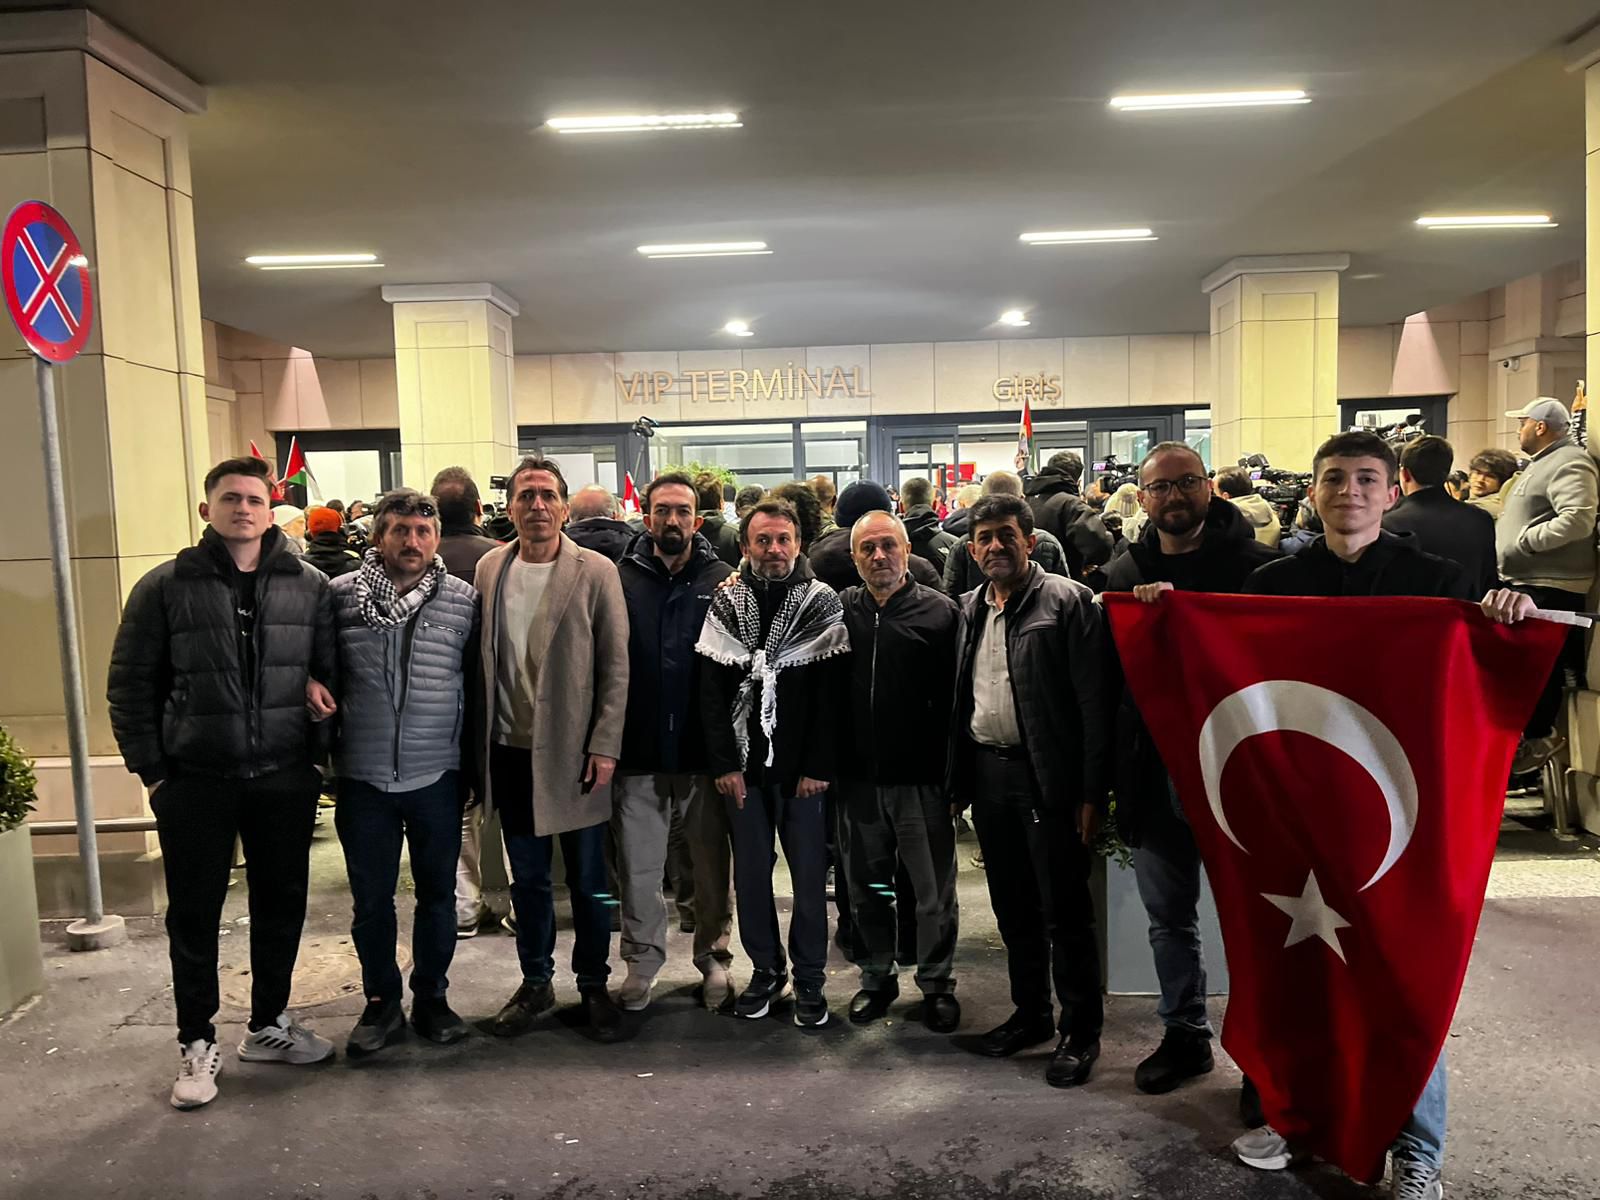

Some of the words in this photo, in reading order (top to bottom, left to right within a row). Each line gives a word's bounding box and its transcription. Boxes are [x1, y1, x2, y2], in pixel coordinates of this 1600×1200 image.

[615, 371, 673, 404] VIP
[682, 361, 872, 402] TERMİNAL
[992, 373, 1062, 405] GİRİŞ
